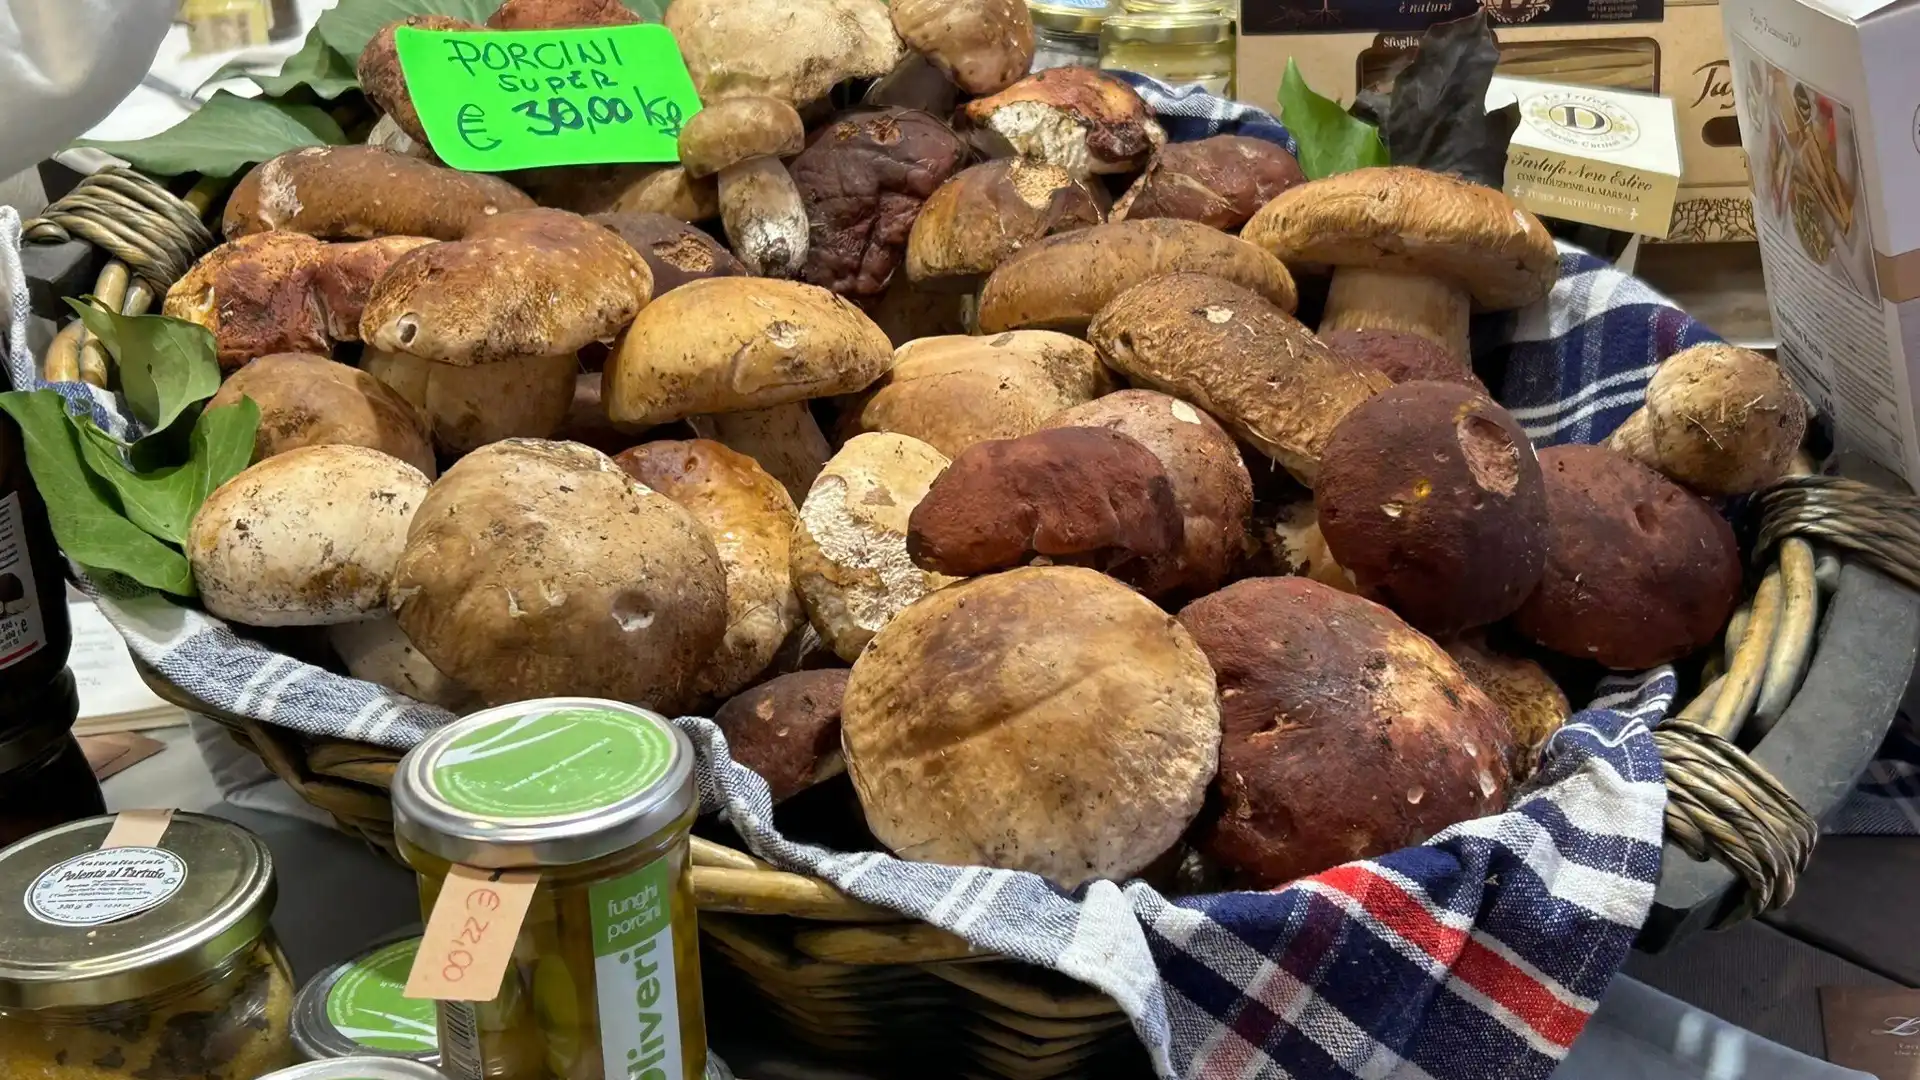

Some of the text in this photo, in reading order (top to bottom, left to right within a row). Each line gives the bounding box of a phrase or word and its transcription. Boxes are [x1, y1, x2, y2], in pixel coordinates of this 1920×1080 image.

[443, 37, 624, 77] PORCINI
[497, 69, 619, 95] SUPER
[457, 103, 503, 151] €
[1564, 106, 1606, 130] D
[1510, 151, 1653, 192] Tartufo Nero Estivo
[106, 866, 121, 878] al
[121, 866, 166, 880] Tartufo
[608, 883, 659, 917] funghi
[441, 887, 501, 983] € 22,00
[607, 902, 662, 942] porcini
